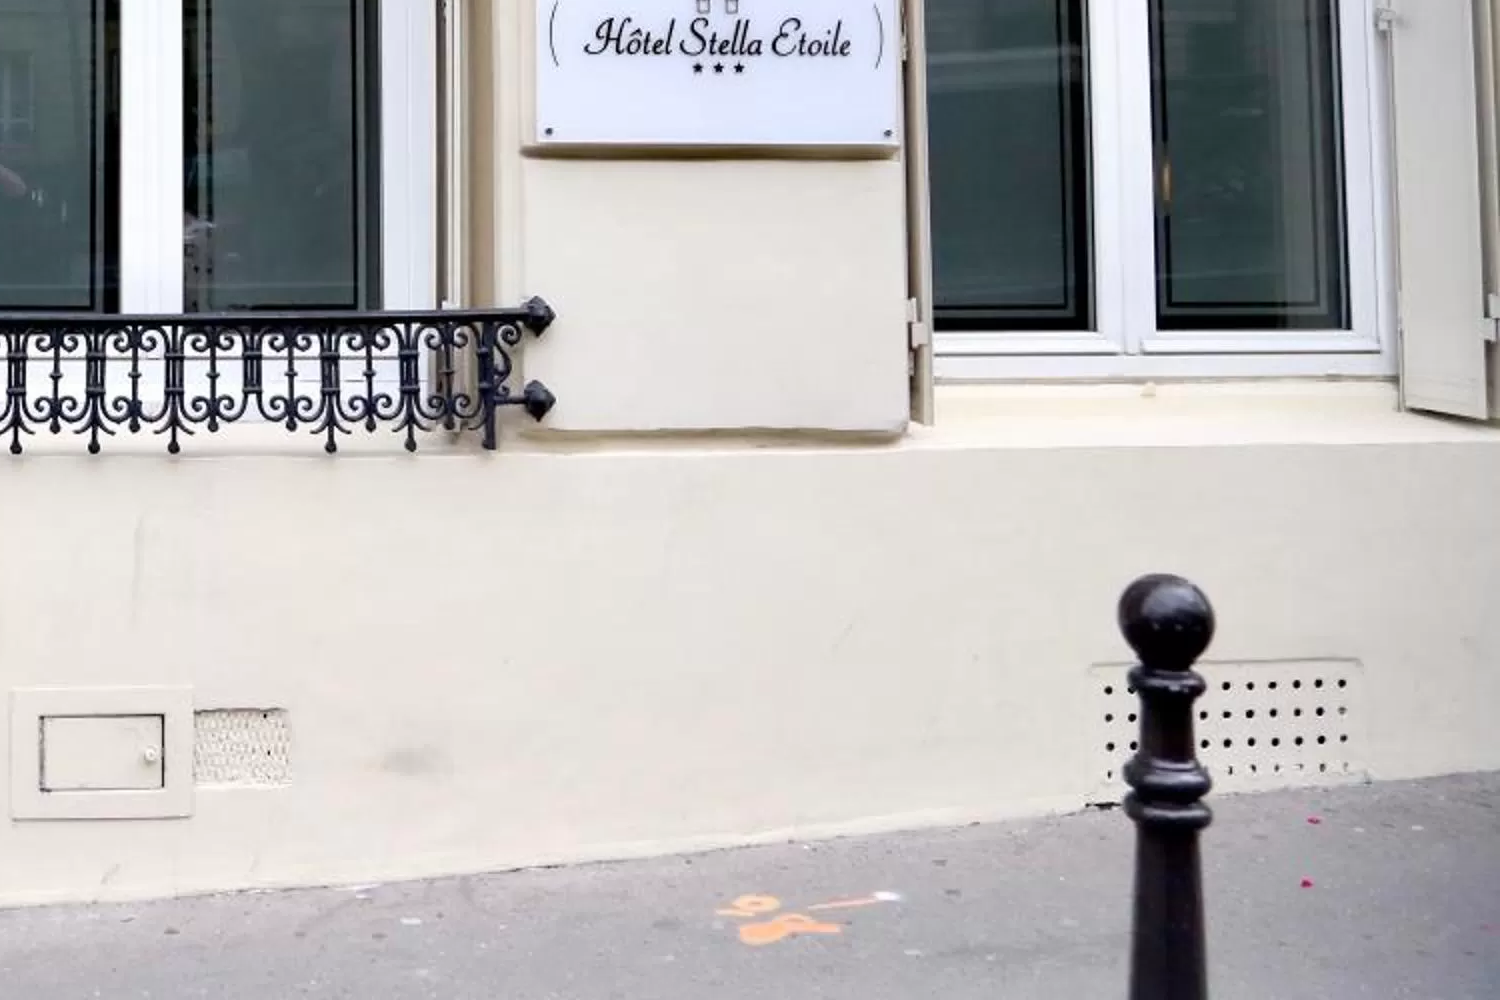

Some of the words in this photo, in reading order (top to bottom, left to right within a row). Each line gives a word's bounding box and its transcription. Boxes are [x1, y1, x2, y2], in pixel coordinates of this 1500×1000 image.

[583, 17, 676, 55] Hôtel
[679, 17, 763, 57] Stella
[771, 17, 851, 57] Etoile
